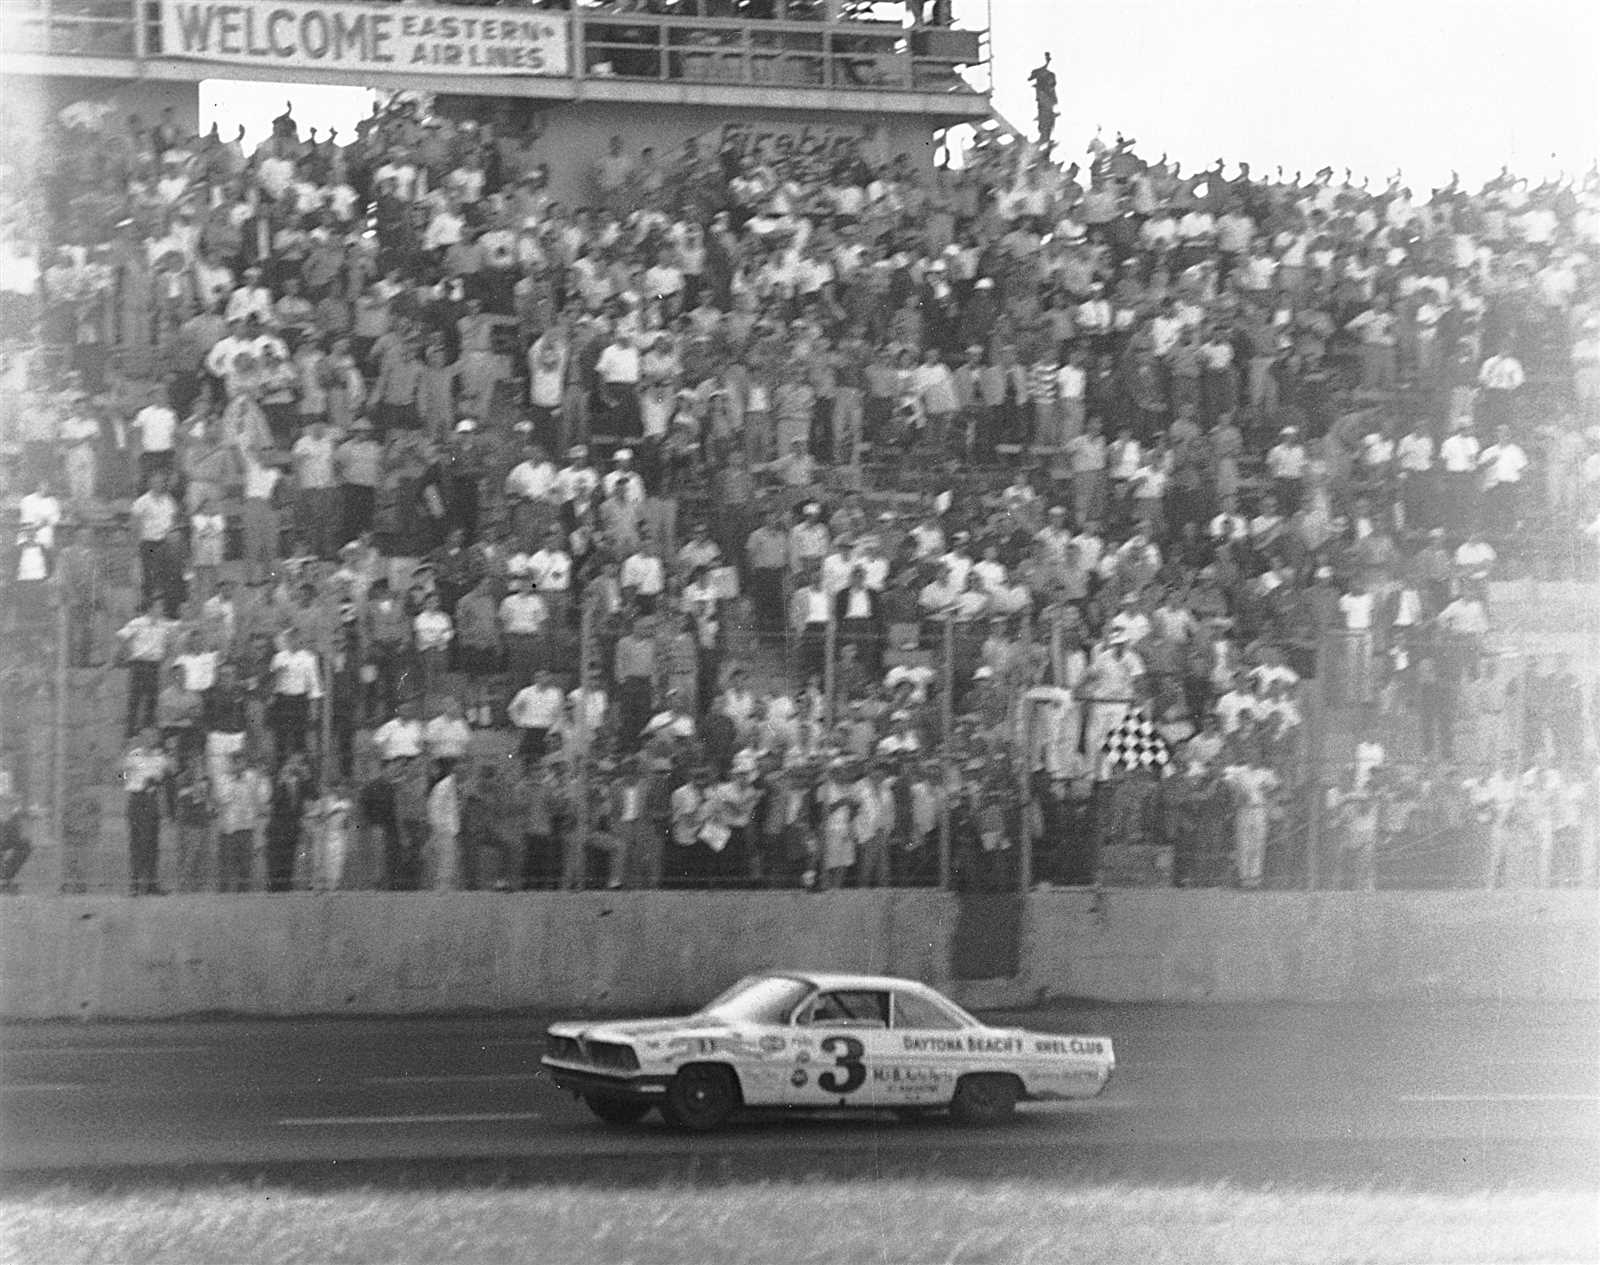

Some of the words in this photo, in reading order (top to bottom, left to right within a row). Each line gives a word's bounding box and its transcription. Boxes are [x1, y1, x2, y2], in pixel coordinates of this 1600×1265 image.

[174, 5, 394, 62] WELCOME
[818, 1035, 867, 1094] 3
[903, 1036, 962, 1053] DAYTONA
